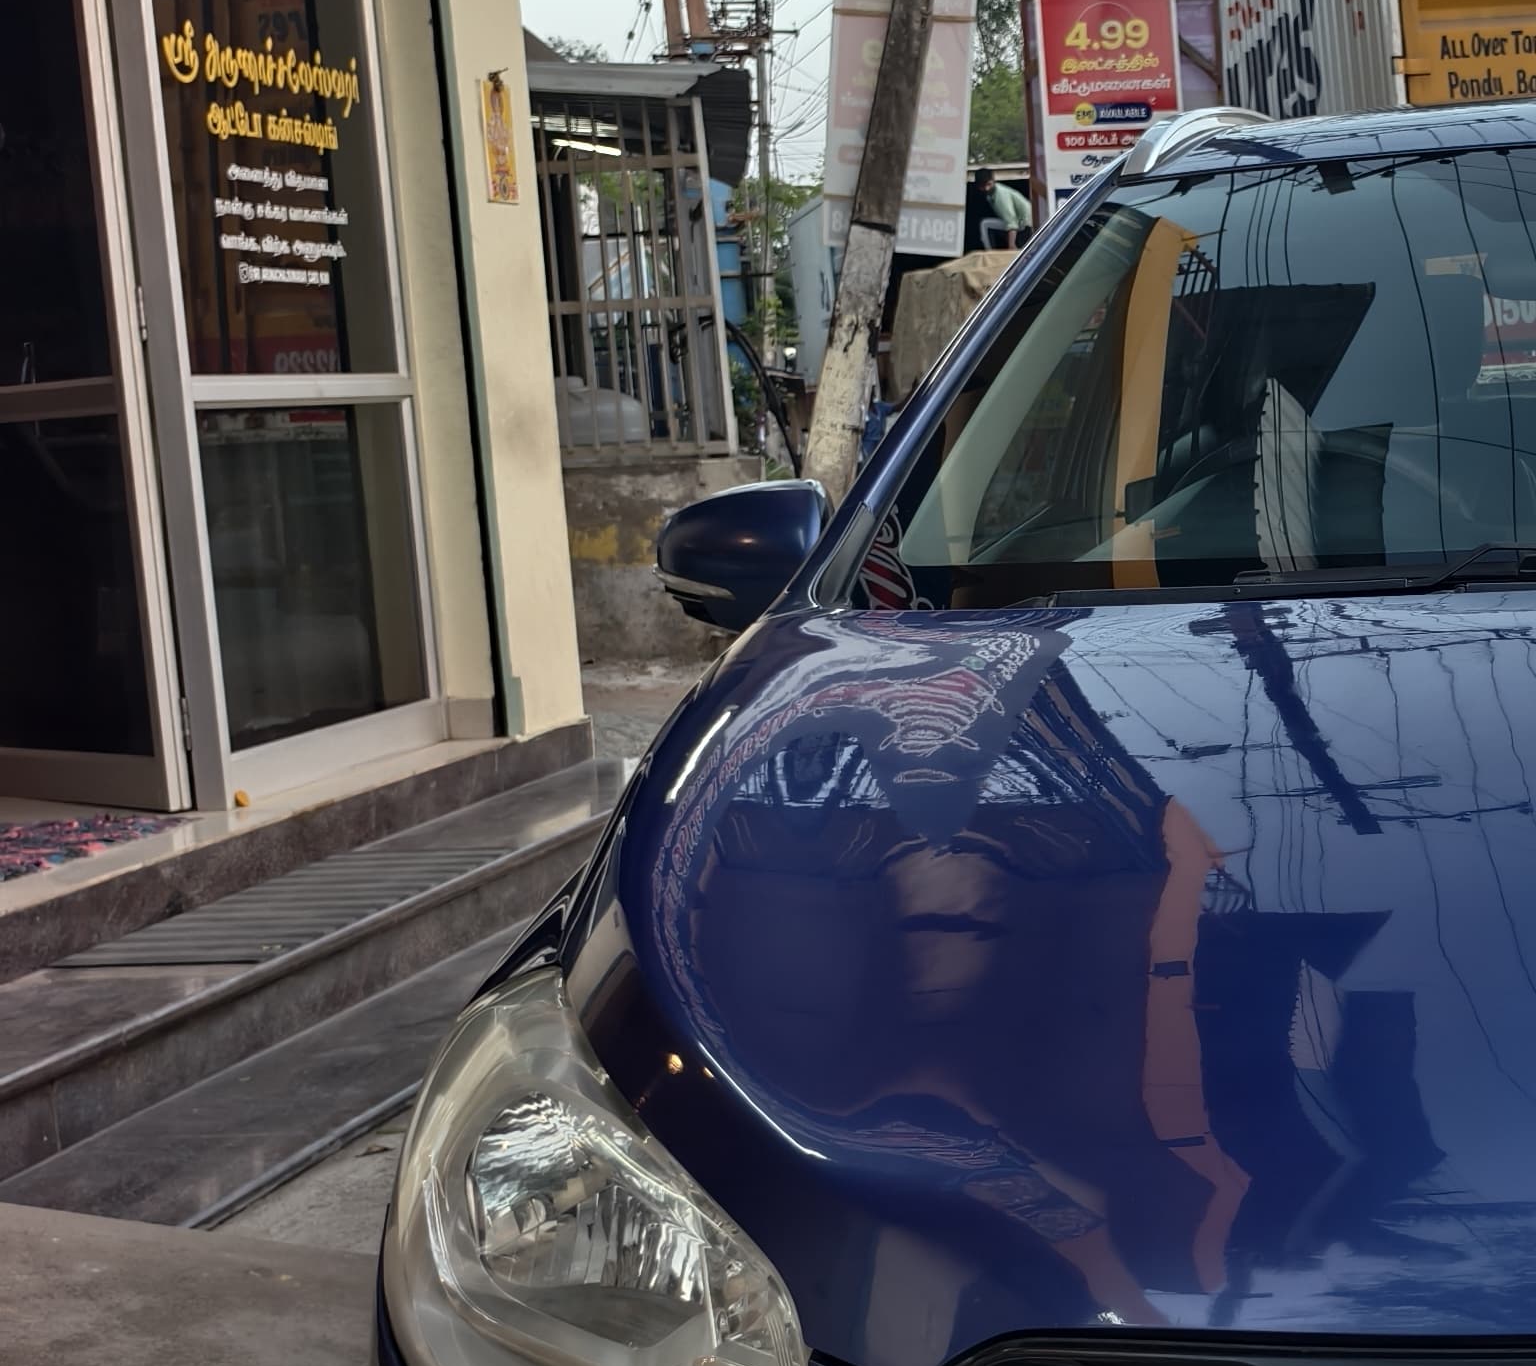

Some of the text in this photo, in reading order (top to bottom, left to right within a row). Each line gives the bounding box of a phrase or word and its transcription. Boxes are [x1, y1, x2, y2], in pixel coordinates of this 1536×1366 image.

[1065, 19, 1149, 51] 4.99
[1471, 32, 1508, 57] Over
[207, 100, 263, 140] ஆட்டோ
[1100, 107, 1148, 119] AVAILABLE
[1064, 136, 1085, 147] 100
